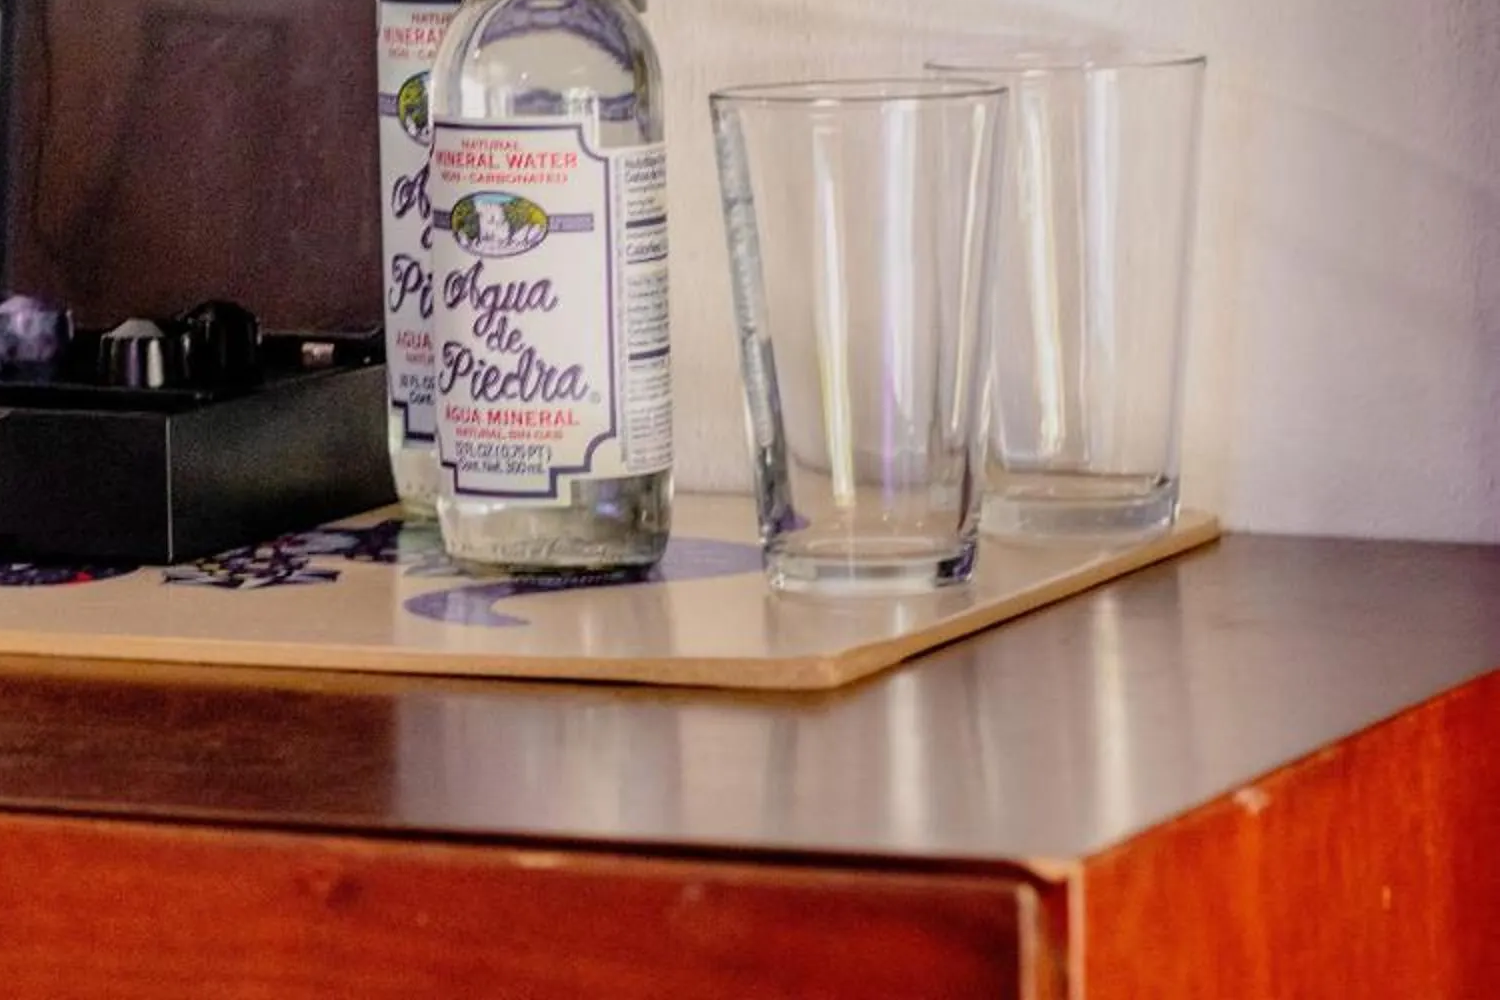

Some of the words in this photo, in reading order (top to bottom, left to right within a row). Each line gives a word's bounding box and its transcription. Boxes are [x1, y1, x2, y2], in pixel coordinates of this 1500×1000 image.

[411, 12, 452, 24] NATUR
[461, 138, 519, 151] NATURAL
[436, 151, 498, 168] MINERAL
[507, 152, 578, 169] WATER
[443, 260, 558, 336] Agua
[487, 317, 526, 352] de
[438, 341, 588, 403] Piedra
[445, 403, 481, 424] AGUA
[487, 408, 580, 426] MINERAL
